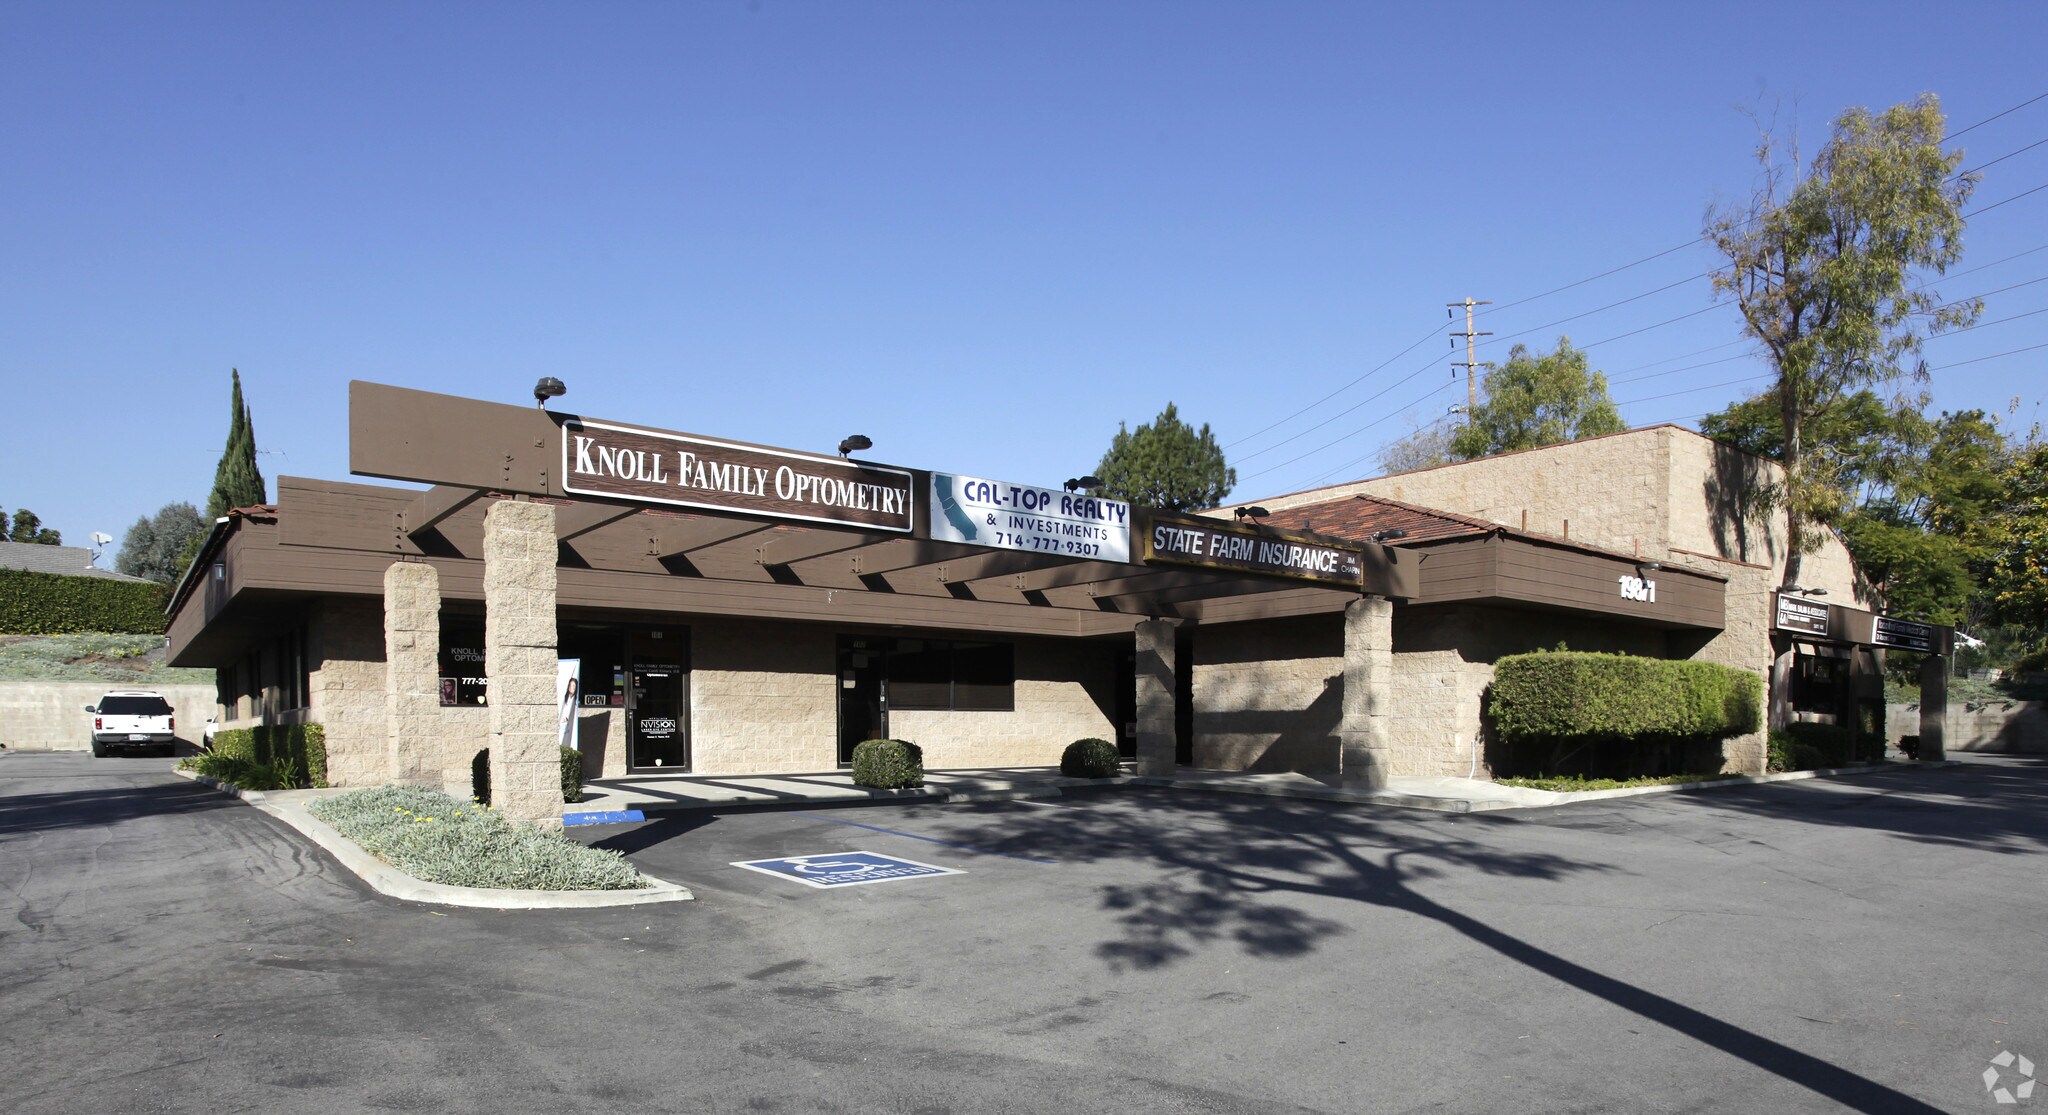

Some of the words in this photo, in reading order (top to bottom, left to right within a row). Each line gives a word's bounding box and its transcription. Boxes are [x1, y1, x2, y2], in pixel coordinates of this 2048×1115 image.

[574, 435, 668, 484] KNOLL
[677, 450, 769, 497] FAMILY
[775, 465, 907, 516] OPTOMETRY
[964, 481, 1051, 511] CAL-TOP
[1060, 495, 1126, 523] REALTY
[986, 513, 997, 526] &
[1009, 516, 1108, 541] INVESTMENTS
[1153, 526, 1205, 555] STATE
[1209, 534, 1254, 562] FARM
[1258, 541, 1339, 573] INSURANCE
[1346, 556, 1355, 564] JIM
[451, 647, 478, 655] KNOLL
[586, 695, 605, 705] OPEN
